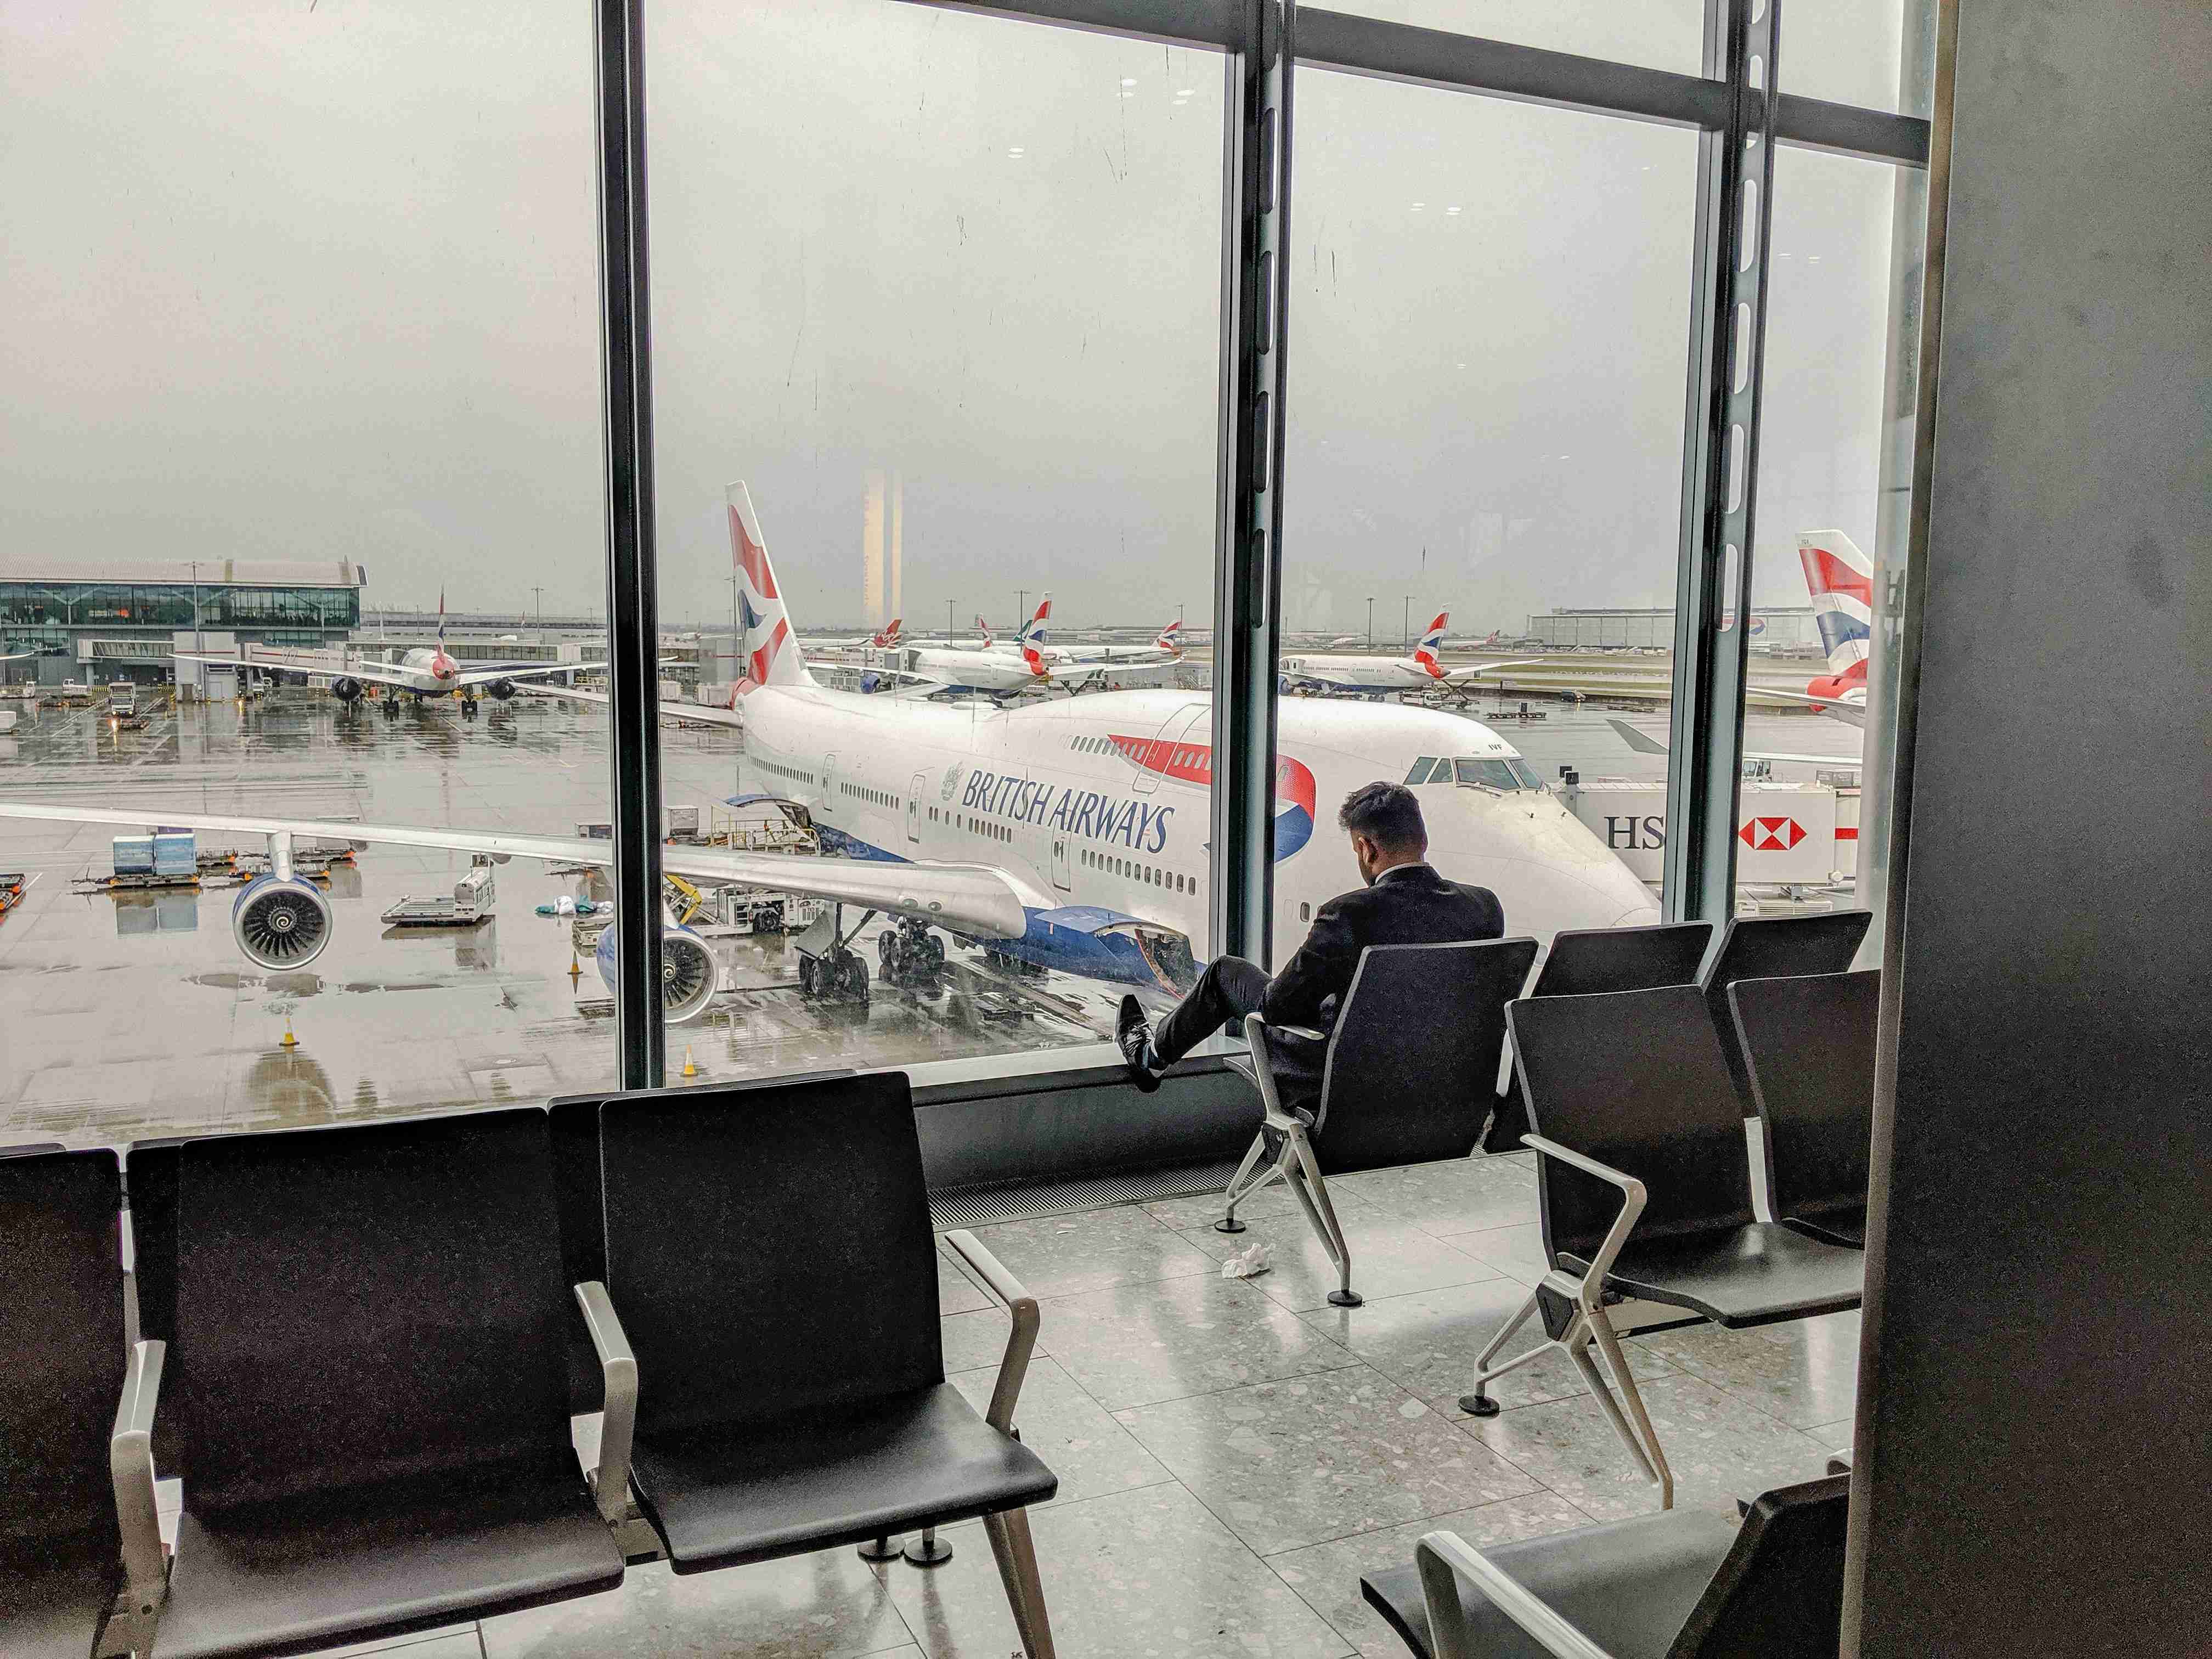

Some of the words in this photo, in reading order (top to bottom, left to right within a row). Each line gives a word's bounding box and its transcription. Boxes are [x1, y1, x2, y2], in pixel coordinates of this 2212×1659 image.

[962, 770, 1054, 825] BRITISH
[1048, 789, 1175, 854] AIRWAYS
[1604, 816, 1664, 850] HS
